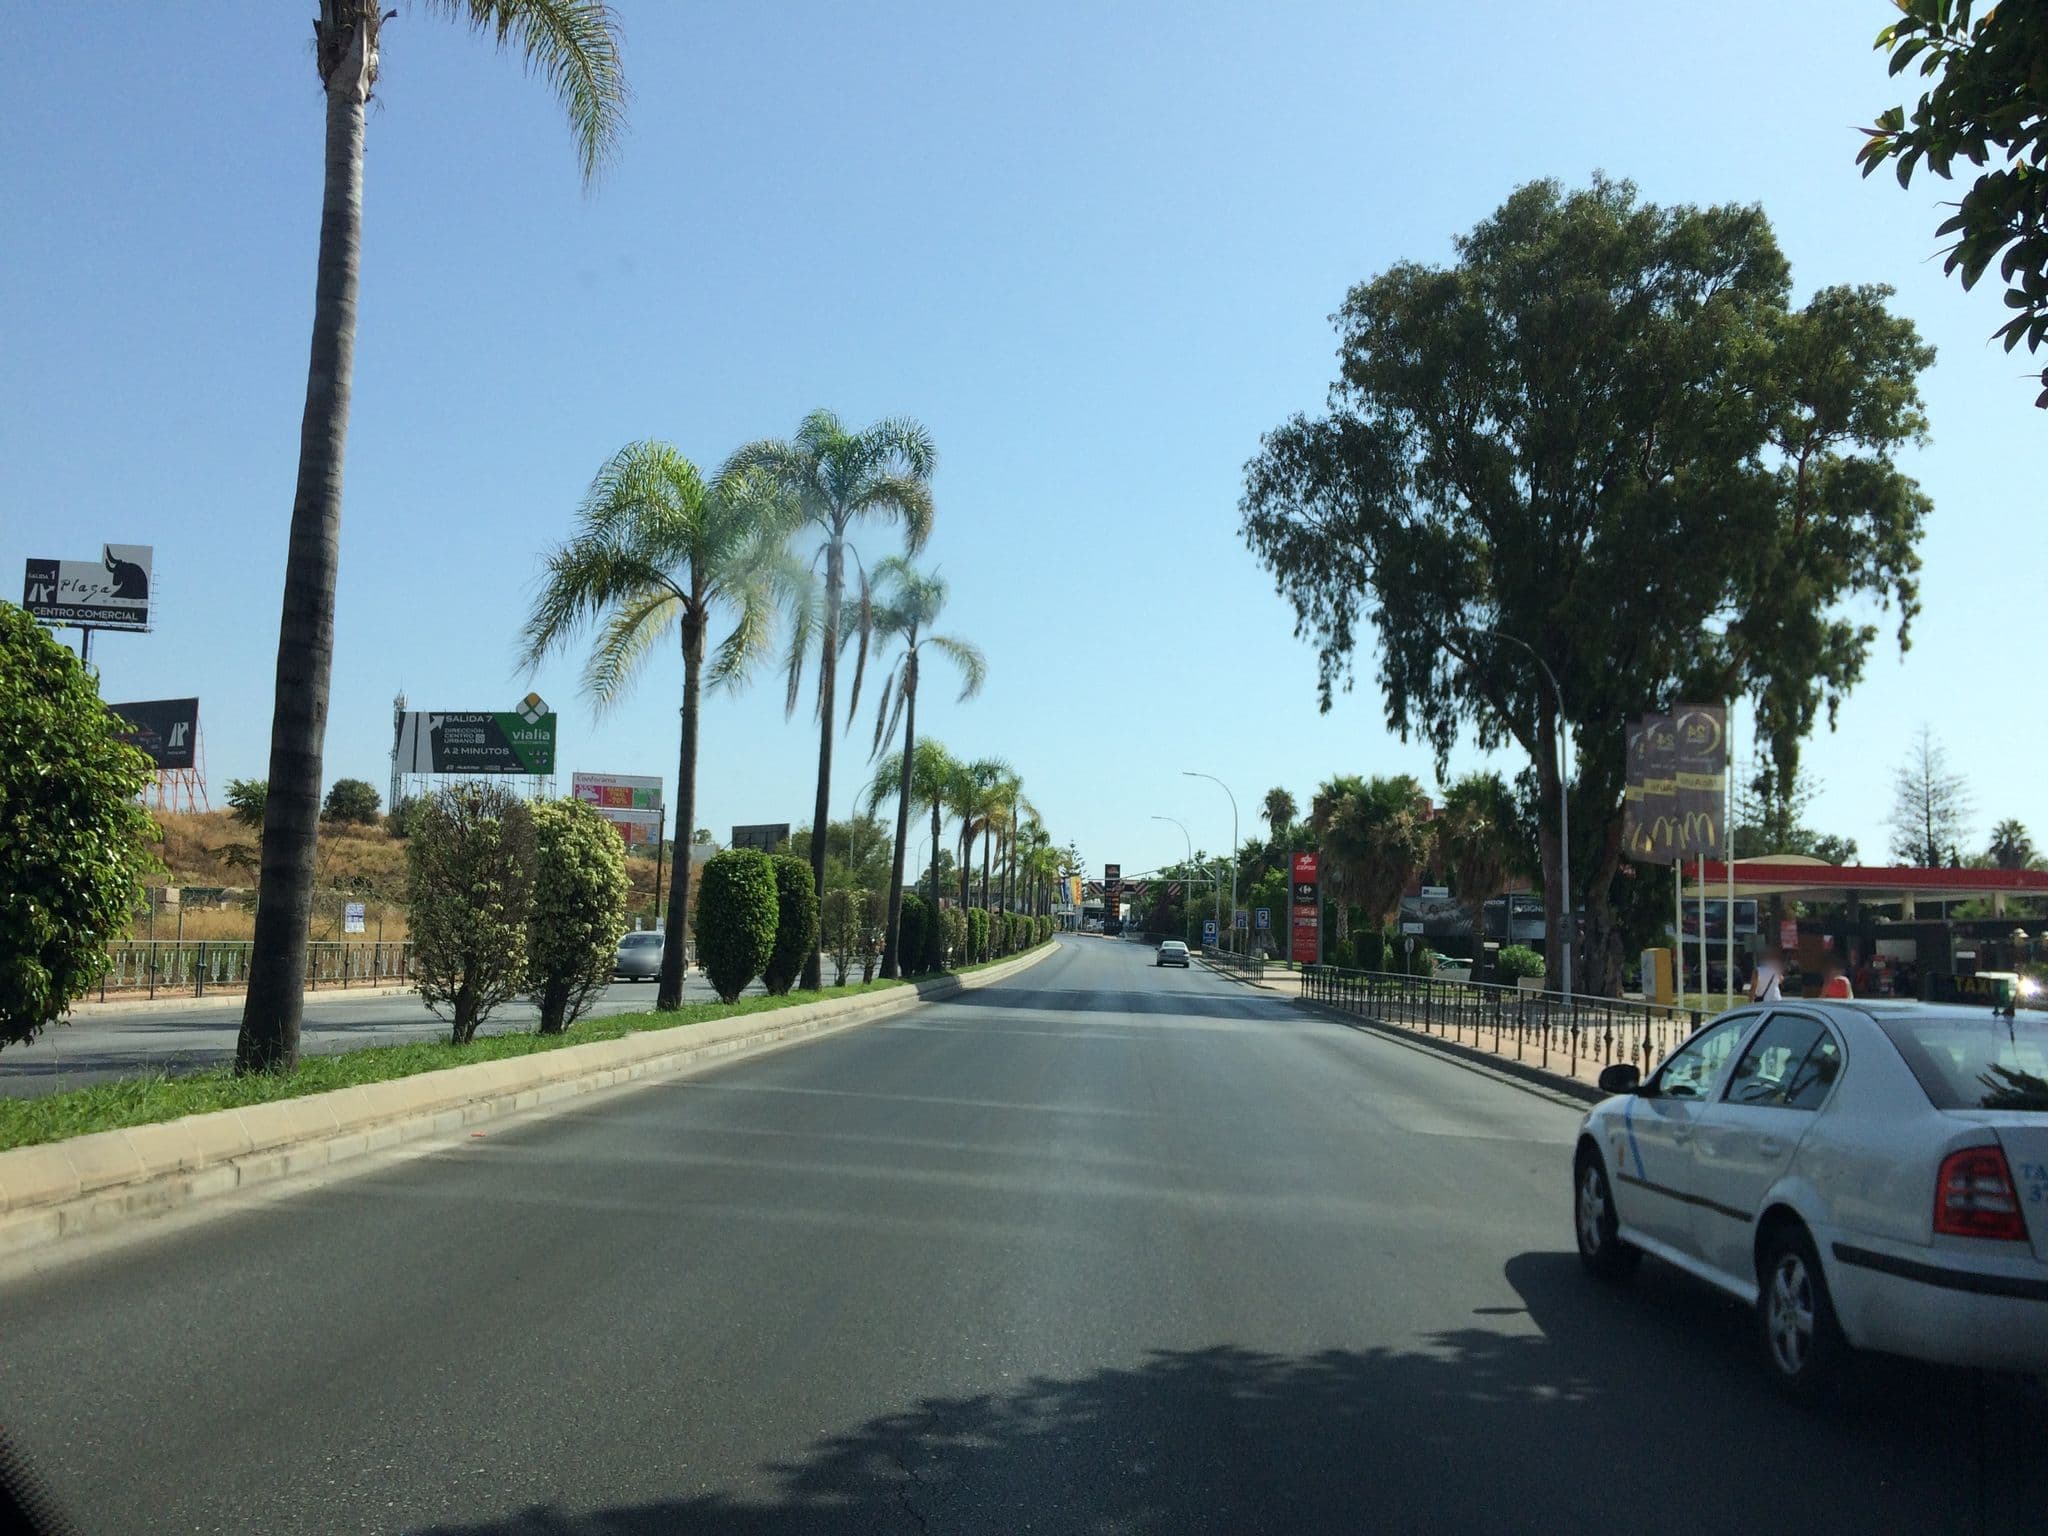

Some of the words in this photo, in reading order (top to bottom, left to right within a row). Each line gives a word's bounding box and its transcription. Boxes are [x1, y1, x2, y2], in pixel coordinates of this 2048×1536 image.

[50, 570, 56, 580] 1
[32, 606, 75, 618] CENTRO
[77, 609, 139, 621] COMERCIAL
[446, 715, 485, 723] SALIDA
[486, 715, 493, 723] 7
[512, 728, 551, 740] vialia
[461, 747, 510, 755] MINUTOS
